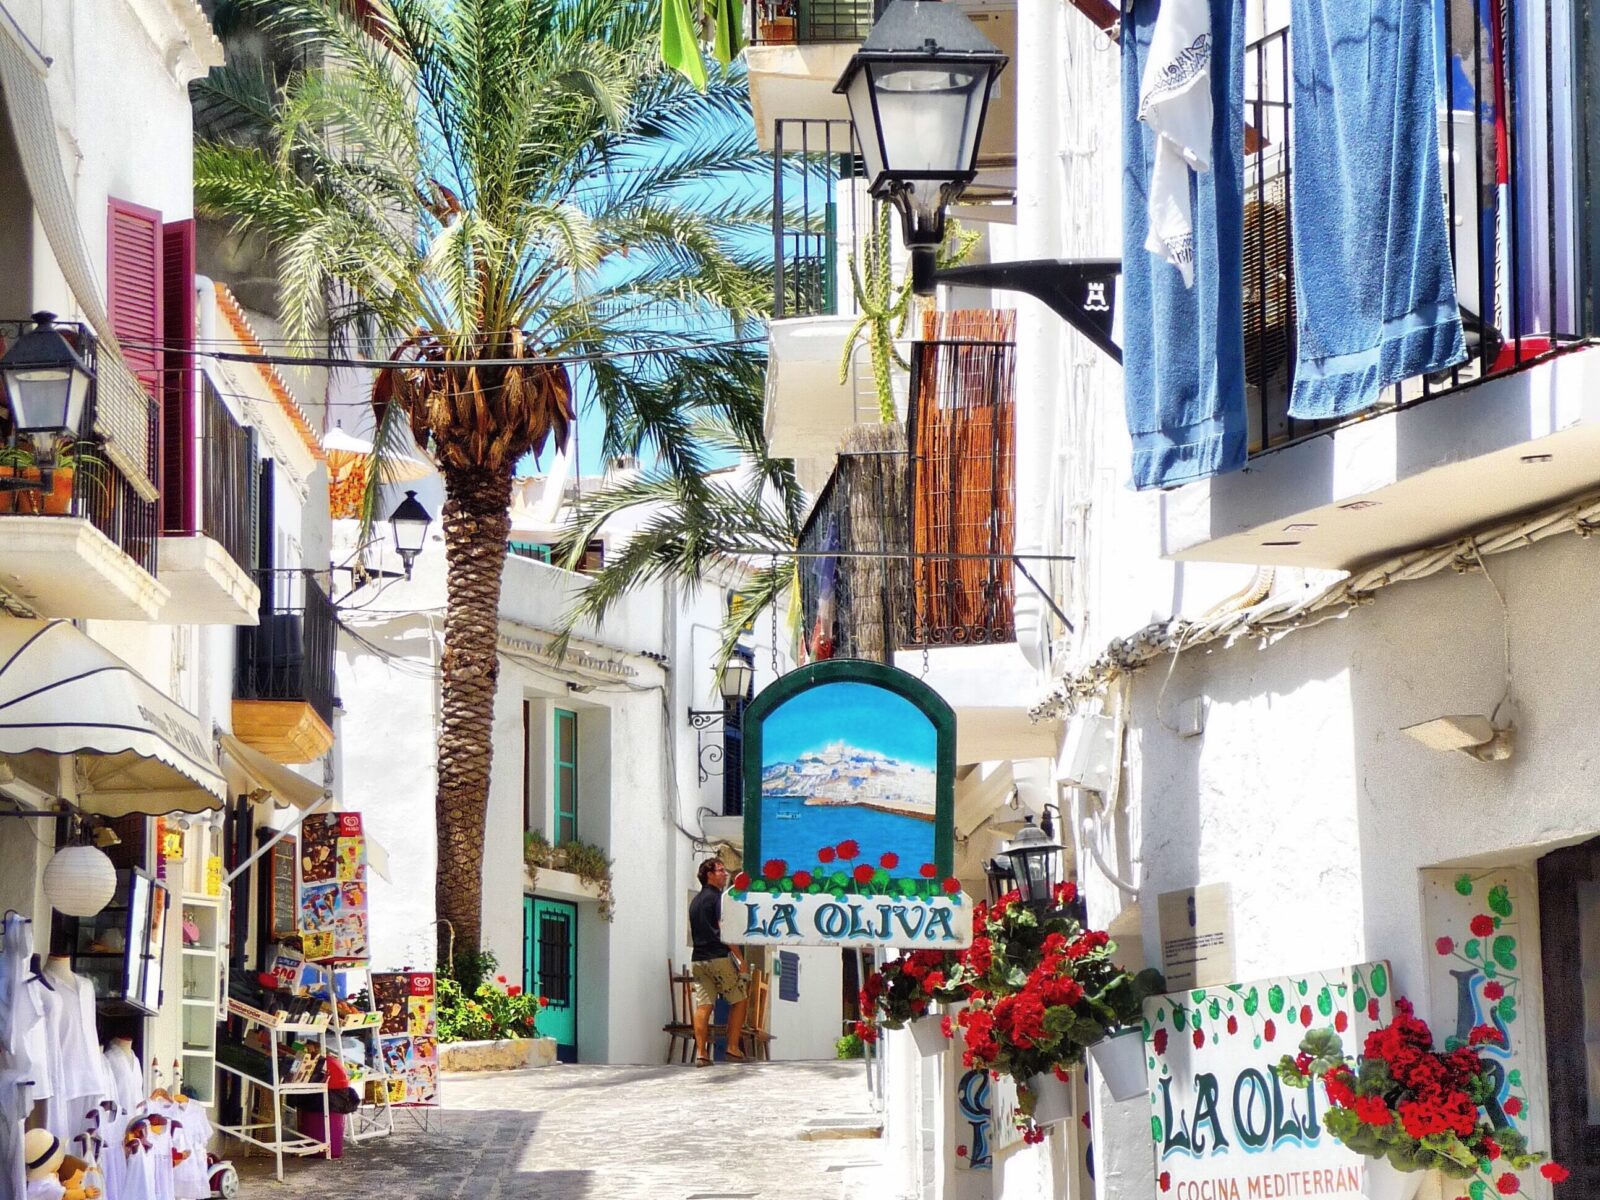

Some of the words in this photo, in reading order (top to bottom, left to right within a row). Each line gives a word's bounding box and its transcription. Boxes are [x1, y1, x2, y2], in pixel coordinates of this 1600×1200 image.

[743, 902, 804, 938] LA
[813, 902, 958, 940] OLIVA
[1158, 1071, 1230, 1159] LA
[1177, 1177, 1241, 1200] COCINA
[1247, 1164, 1365, 1200] MEDITERRÁN
